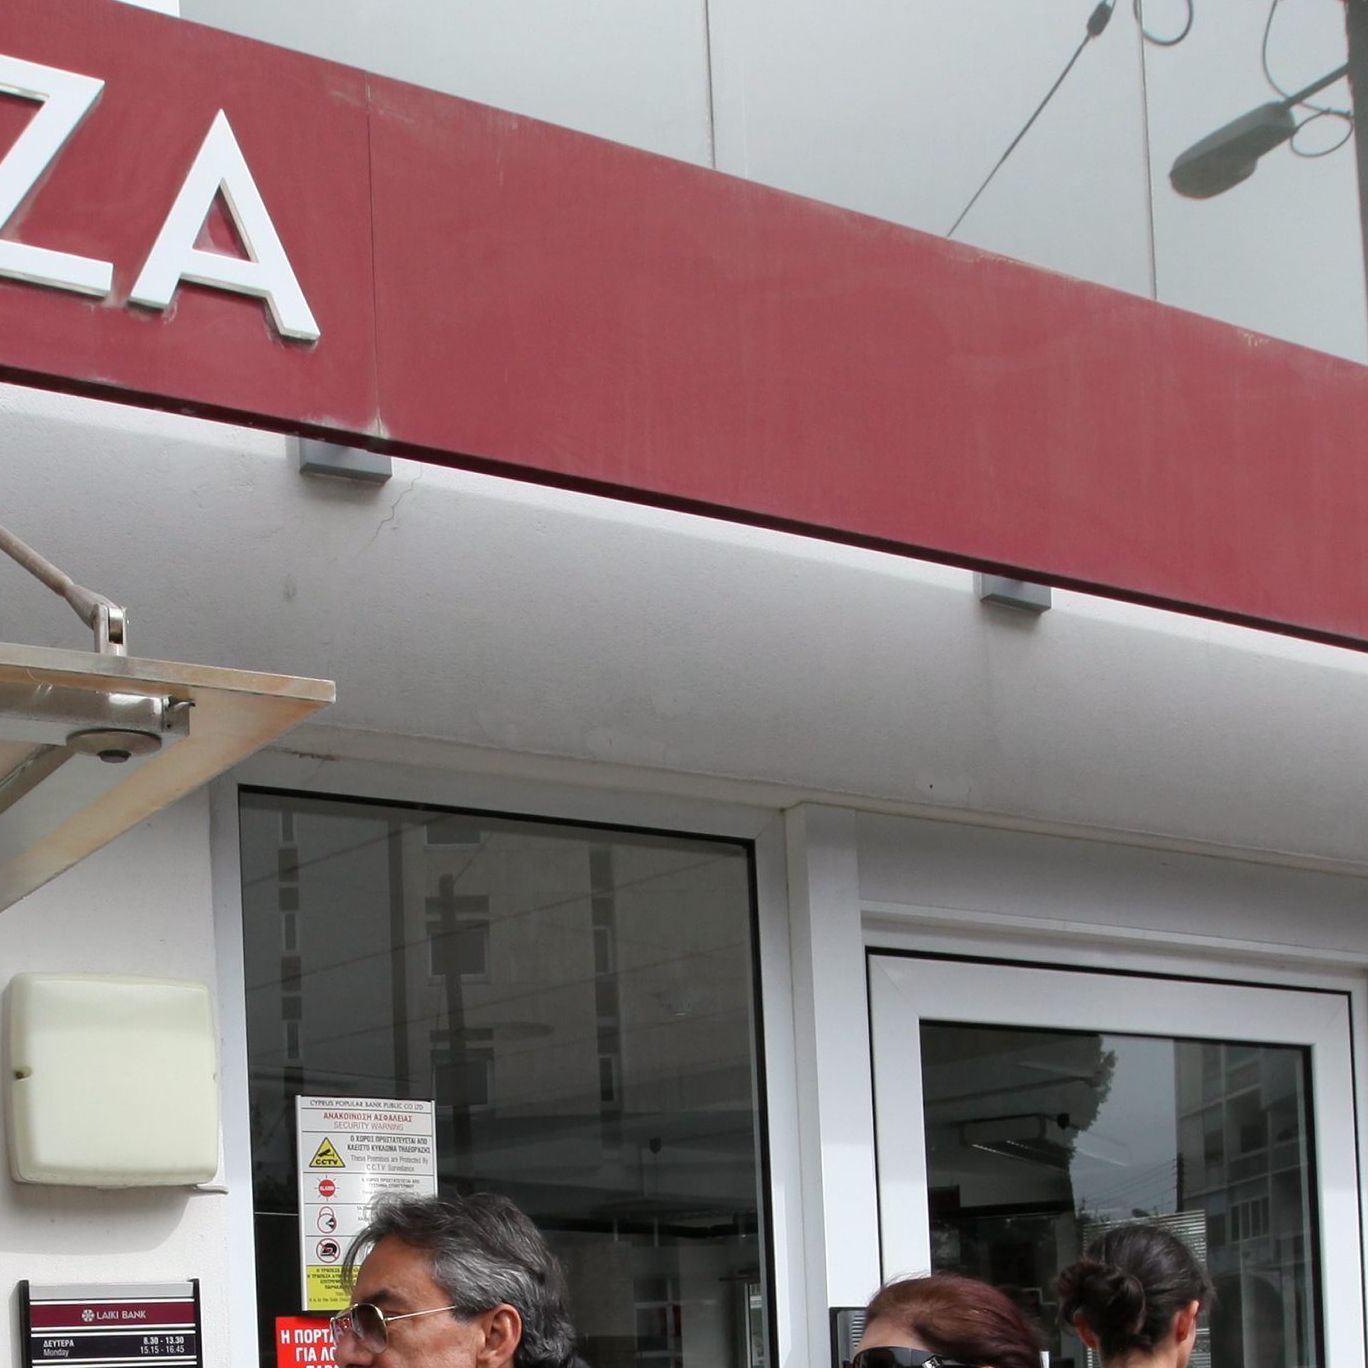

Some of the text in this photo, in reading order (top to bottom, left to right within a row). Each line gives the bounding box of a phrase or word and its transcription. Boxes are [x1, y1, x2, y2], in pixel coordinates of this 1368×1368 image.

[333, 1121, 404, 1131] SECURITY WARNING
[96, 1310, 147, 1320] LAIKI BANK
[143, 1336, 159, 1345] 8.30
[165, 1336, 184, 1344] 13.30
[280, 1330, 290, 1344] Η
[43, 1339, 75, 1348] ΔΕΥΤΕΡΑ
[43, 1348, 70, 1358] Monday
[140, 1346, 159, 1354] 15.15
[165, 1345, 185, 1353] 16.45
[296, 1347, 317, 1362] ΓΙΑ
